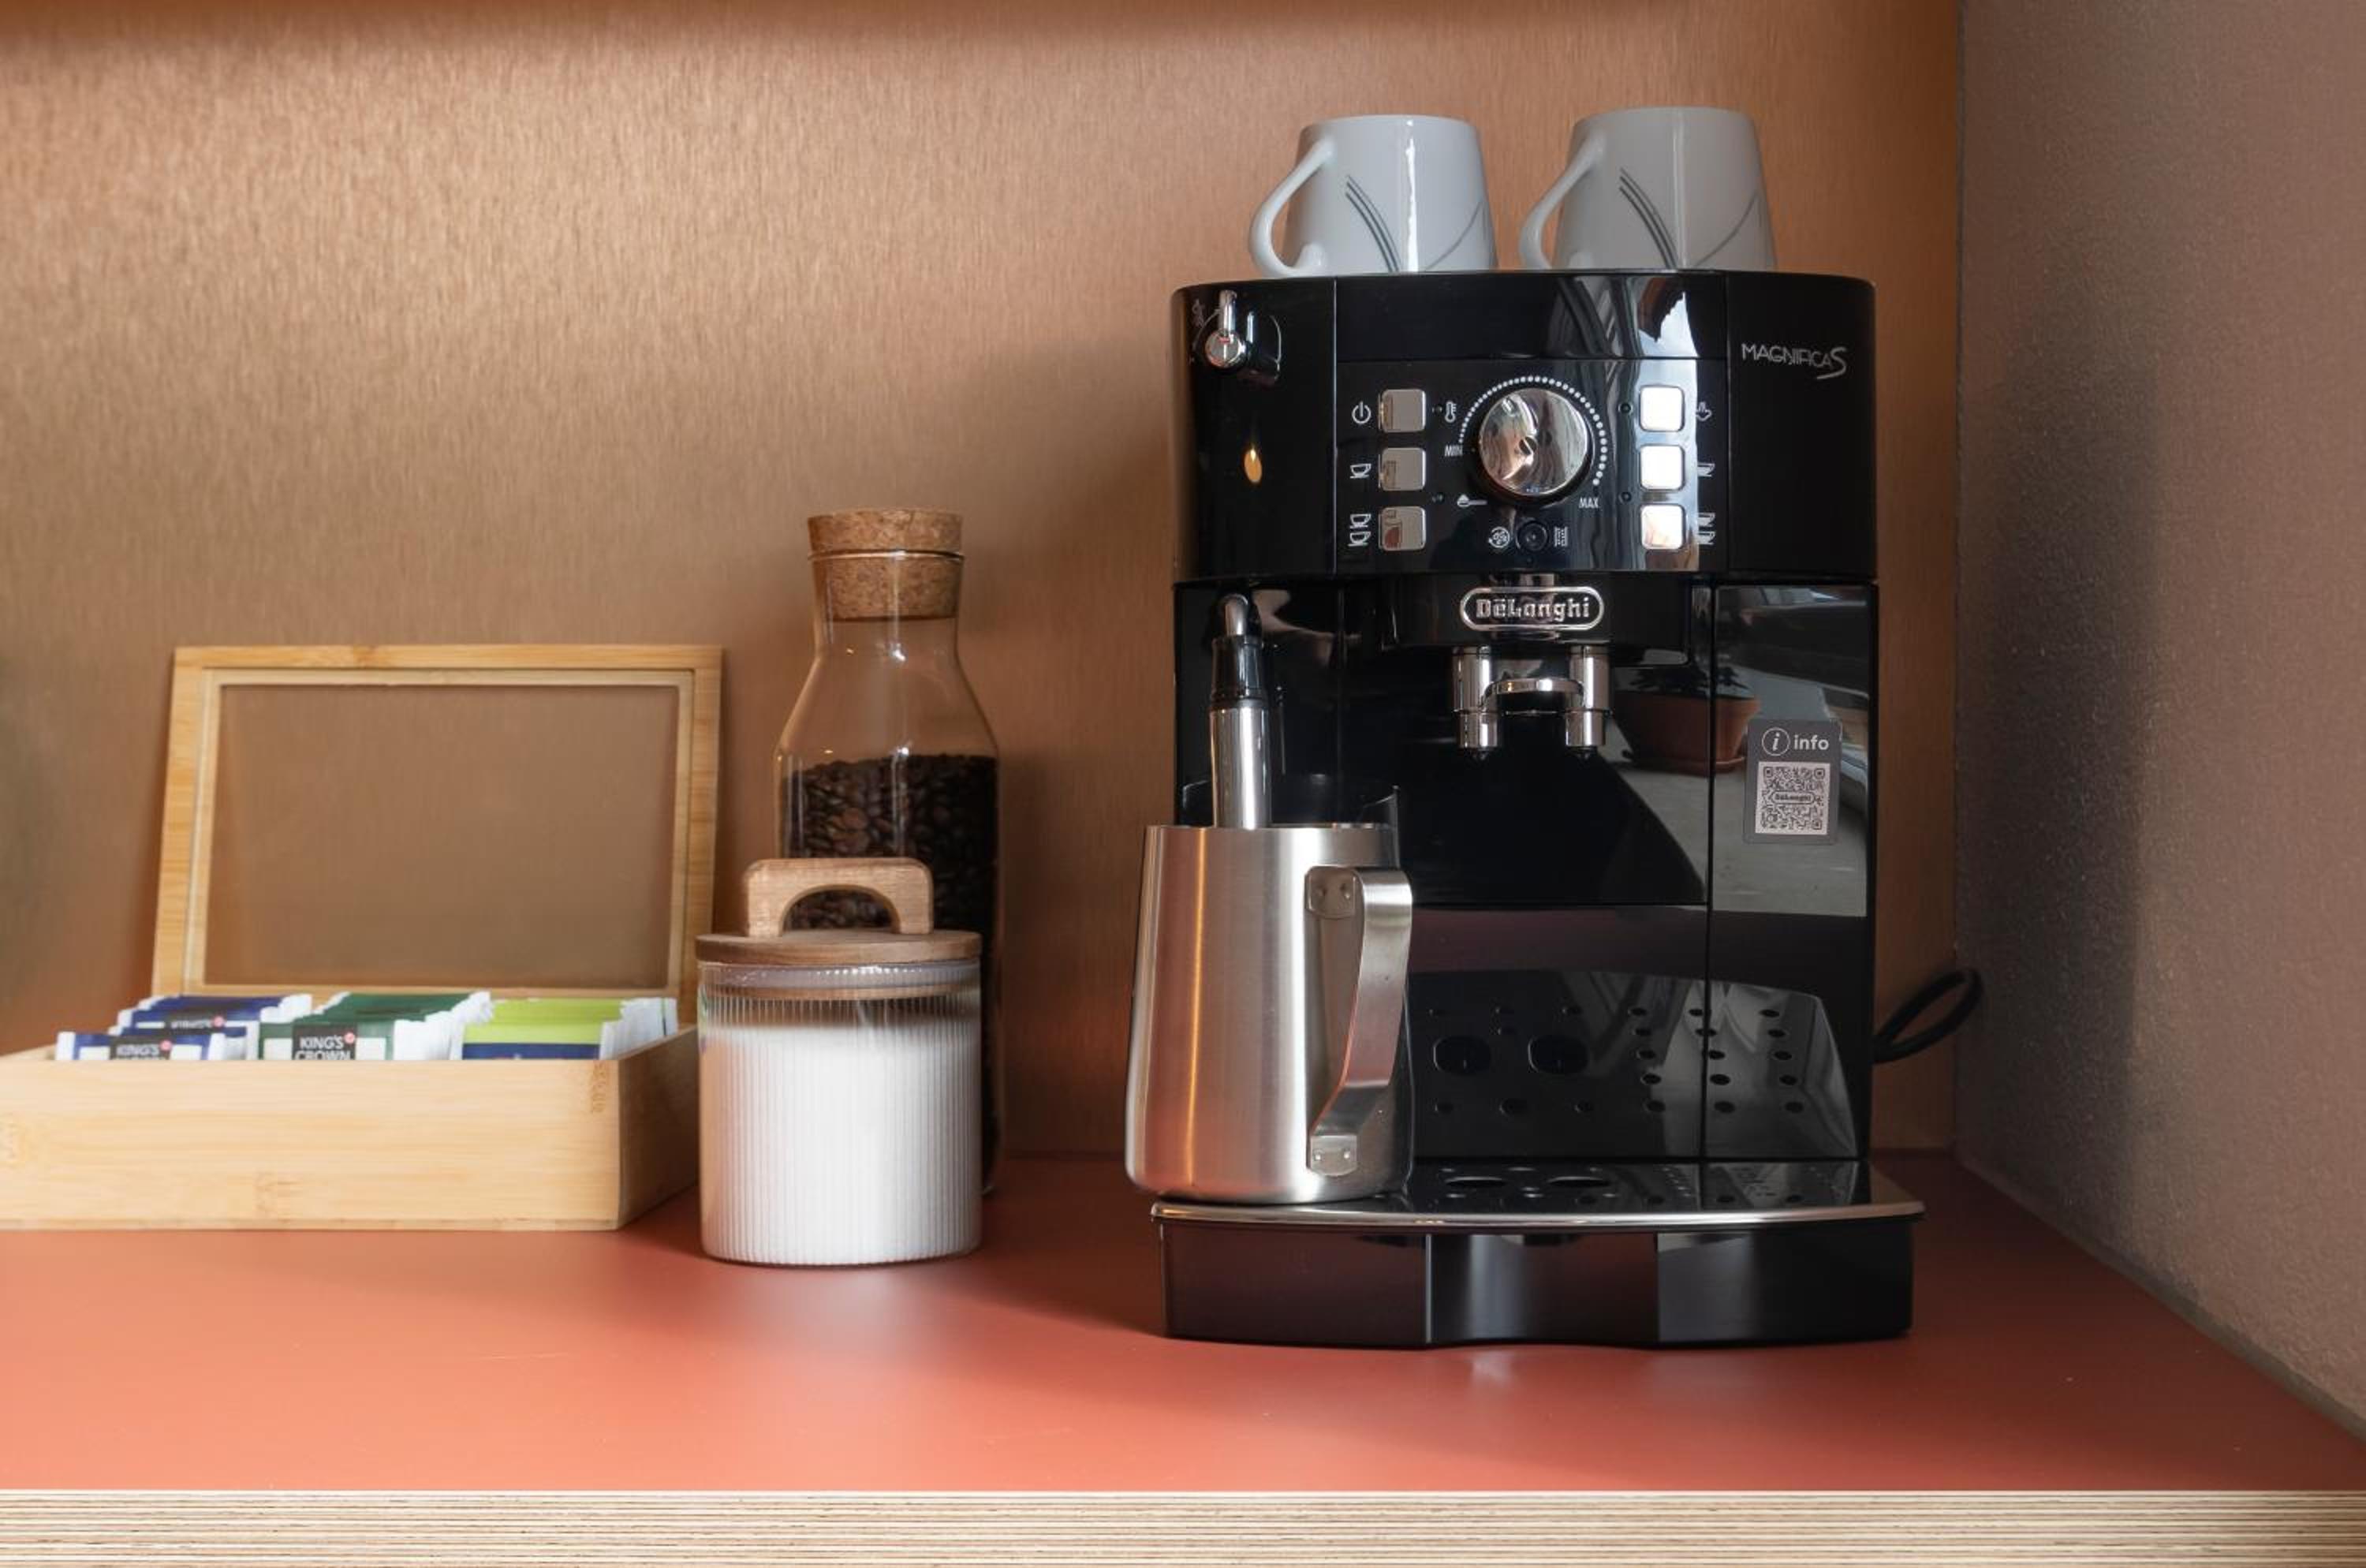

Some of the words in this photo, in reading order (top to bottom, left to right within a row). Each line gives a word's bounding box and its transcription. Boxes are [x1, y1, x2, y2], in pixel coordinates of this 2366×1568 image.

[1444, 444, 1463, 457] MIN
[1578, 497, 1599, 509] MAX
[1793, 734, 1829, 750] info
[300, 1035, 344, 1049] KING'S
[294, 1050, 351, 1060] CROWN
